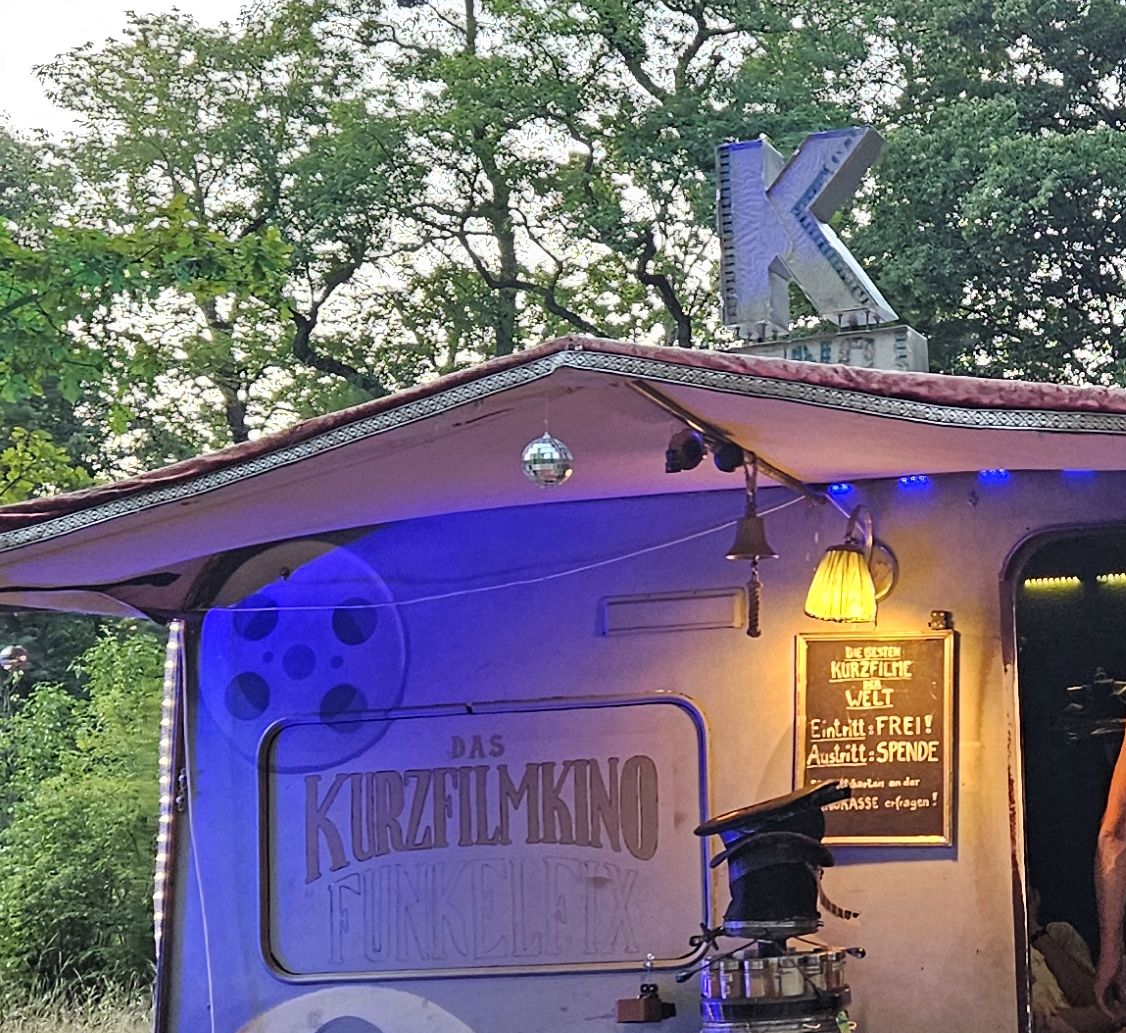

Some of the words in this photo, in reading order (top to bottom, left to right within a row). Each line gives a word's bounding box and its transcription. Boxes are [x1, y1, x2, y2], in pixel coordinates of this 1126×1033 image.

[714, 125, 899, 330] K
[830, 660, 913, 679] KURZFILME
[844, 688, 895, 707] WELT
[450, 734, 506, 759] DAS
[876, 740, 940, 763] SPENDE
[304, 754, 660, 885] KURZFILMKINO
